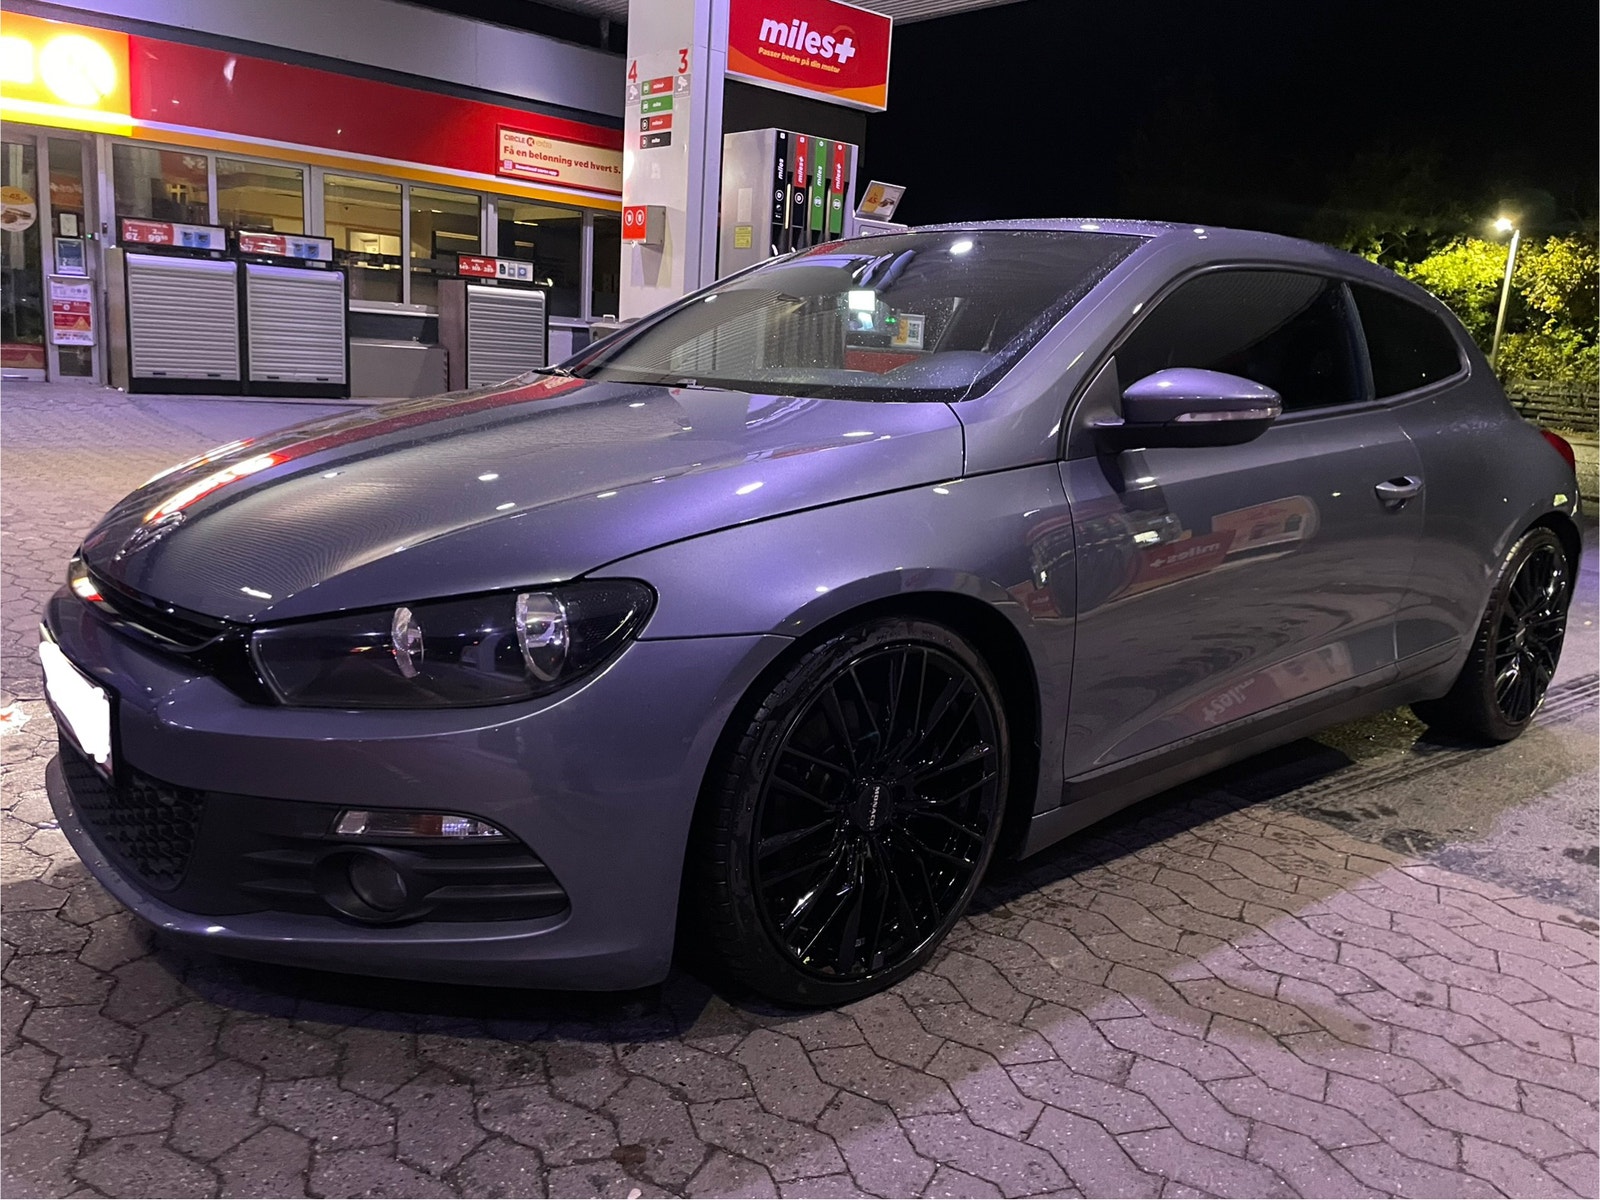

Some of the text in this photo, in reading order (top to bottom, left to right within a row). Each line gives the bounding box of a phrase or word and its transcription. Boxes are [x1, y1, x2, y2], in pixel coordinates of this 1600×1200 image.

[758, 18, 856, 64] miles+
[758, 46, 781, 59] Passer
[628, 59, 638, 83] 4
[677, 48, 688, 74] 3
[503, 133, 526, 144] CIRCLE
[526, 136, 535, 147] K
[503, 145, 514, 155] Få
[516, 149, 527, 158] en
[573, 160, 589, 169] ved
[590, 162, 613, 173] hvert
[613, 165, 622, 174] 5.
[868, 786, 880, 826] MONACO
